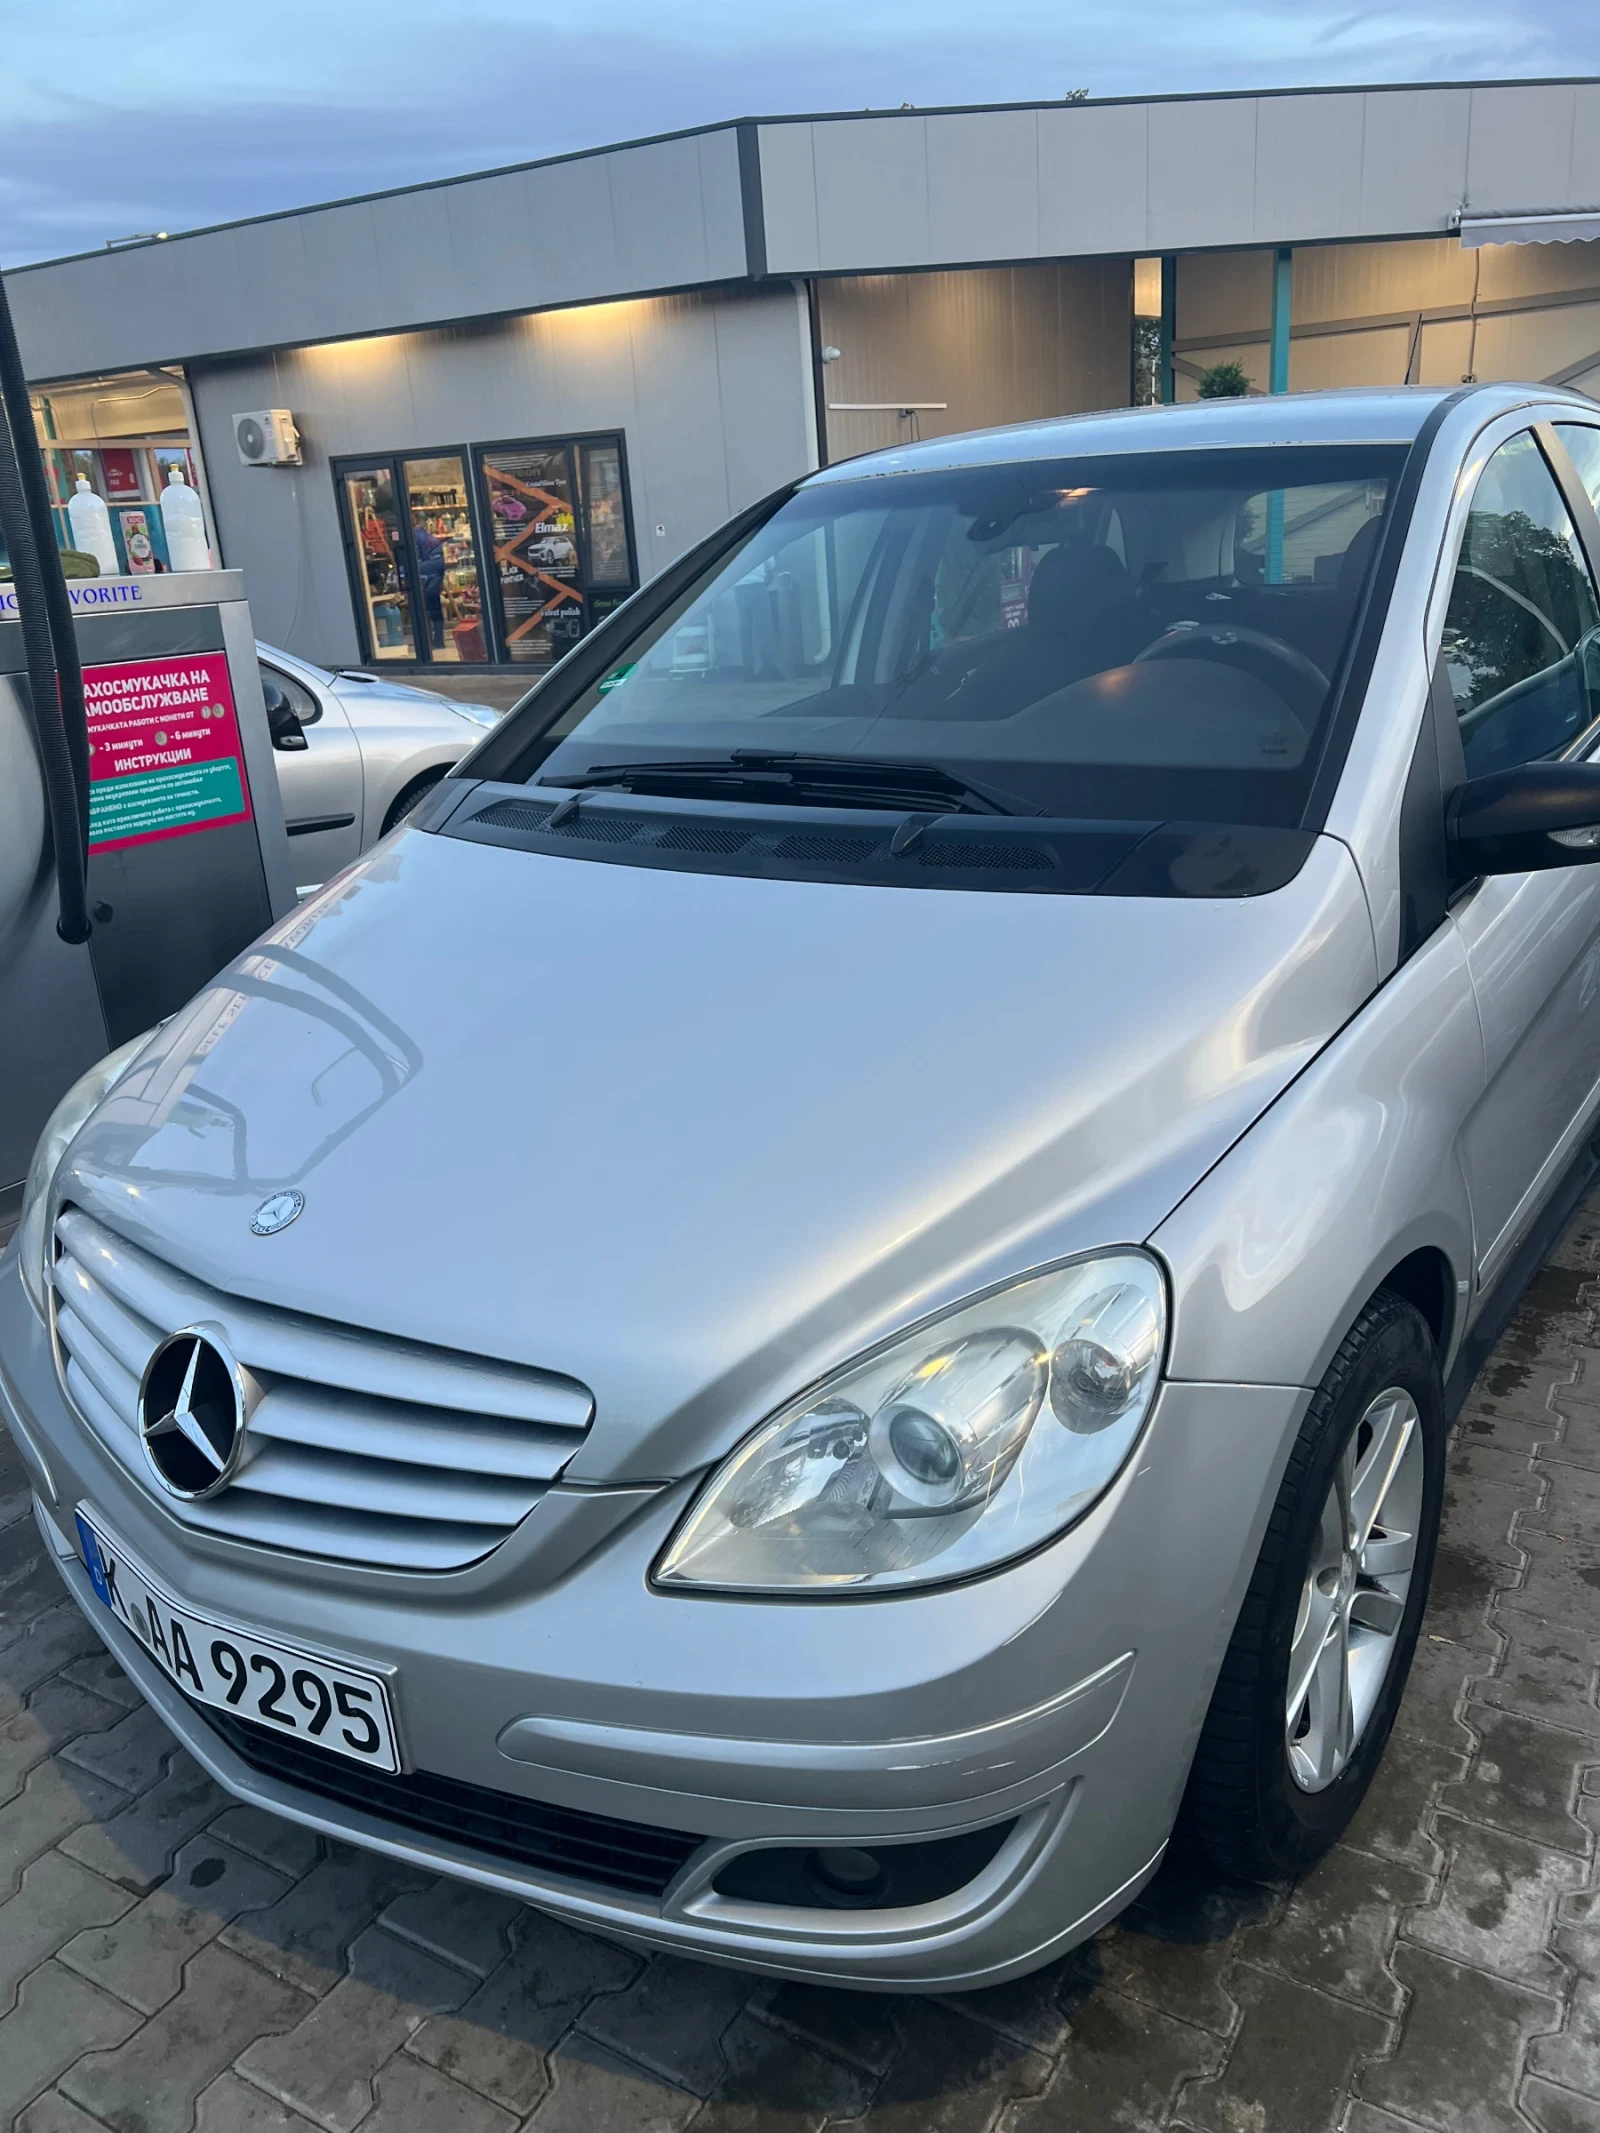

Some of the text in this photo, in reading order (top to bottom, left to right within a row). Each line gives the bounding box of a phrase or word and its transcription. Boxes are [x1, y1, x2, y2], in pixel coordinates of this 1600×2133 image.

[535, 522, 569, 534] Elmaz
[68, 585, 143, 605] VORITE
[560, 606, 581, 619] polish
[84, 669, 211, 698] АХОСМУКАЧКА НА
[87, 720, 128, 734] МУКАЧКАТА
[128, 715, 155, 728] РАБОТИ
[155, 716, 160, 724] С
[159, 712, 186, 723] МОНЕТИ
[186, 711, 195, 719] ОТ
[174, 731, 181, 741] 6
[181, 728, 211, 740] минути
[104, 742, 111, 752] 3
[111, 739, 143, 751] минути
[114, 748, 192, 772] ИНСТРУКЦИИ
[93, 1565, 103, 1586] D
[98, 1543, 381, 1754] K AA 9295
